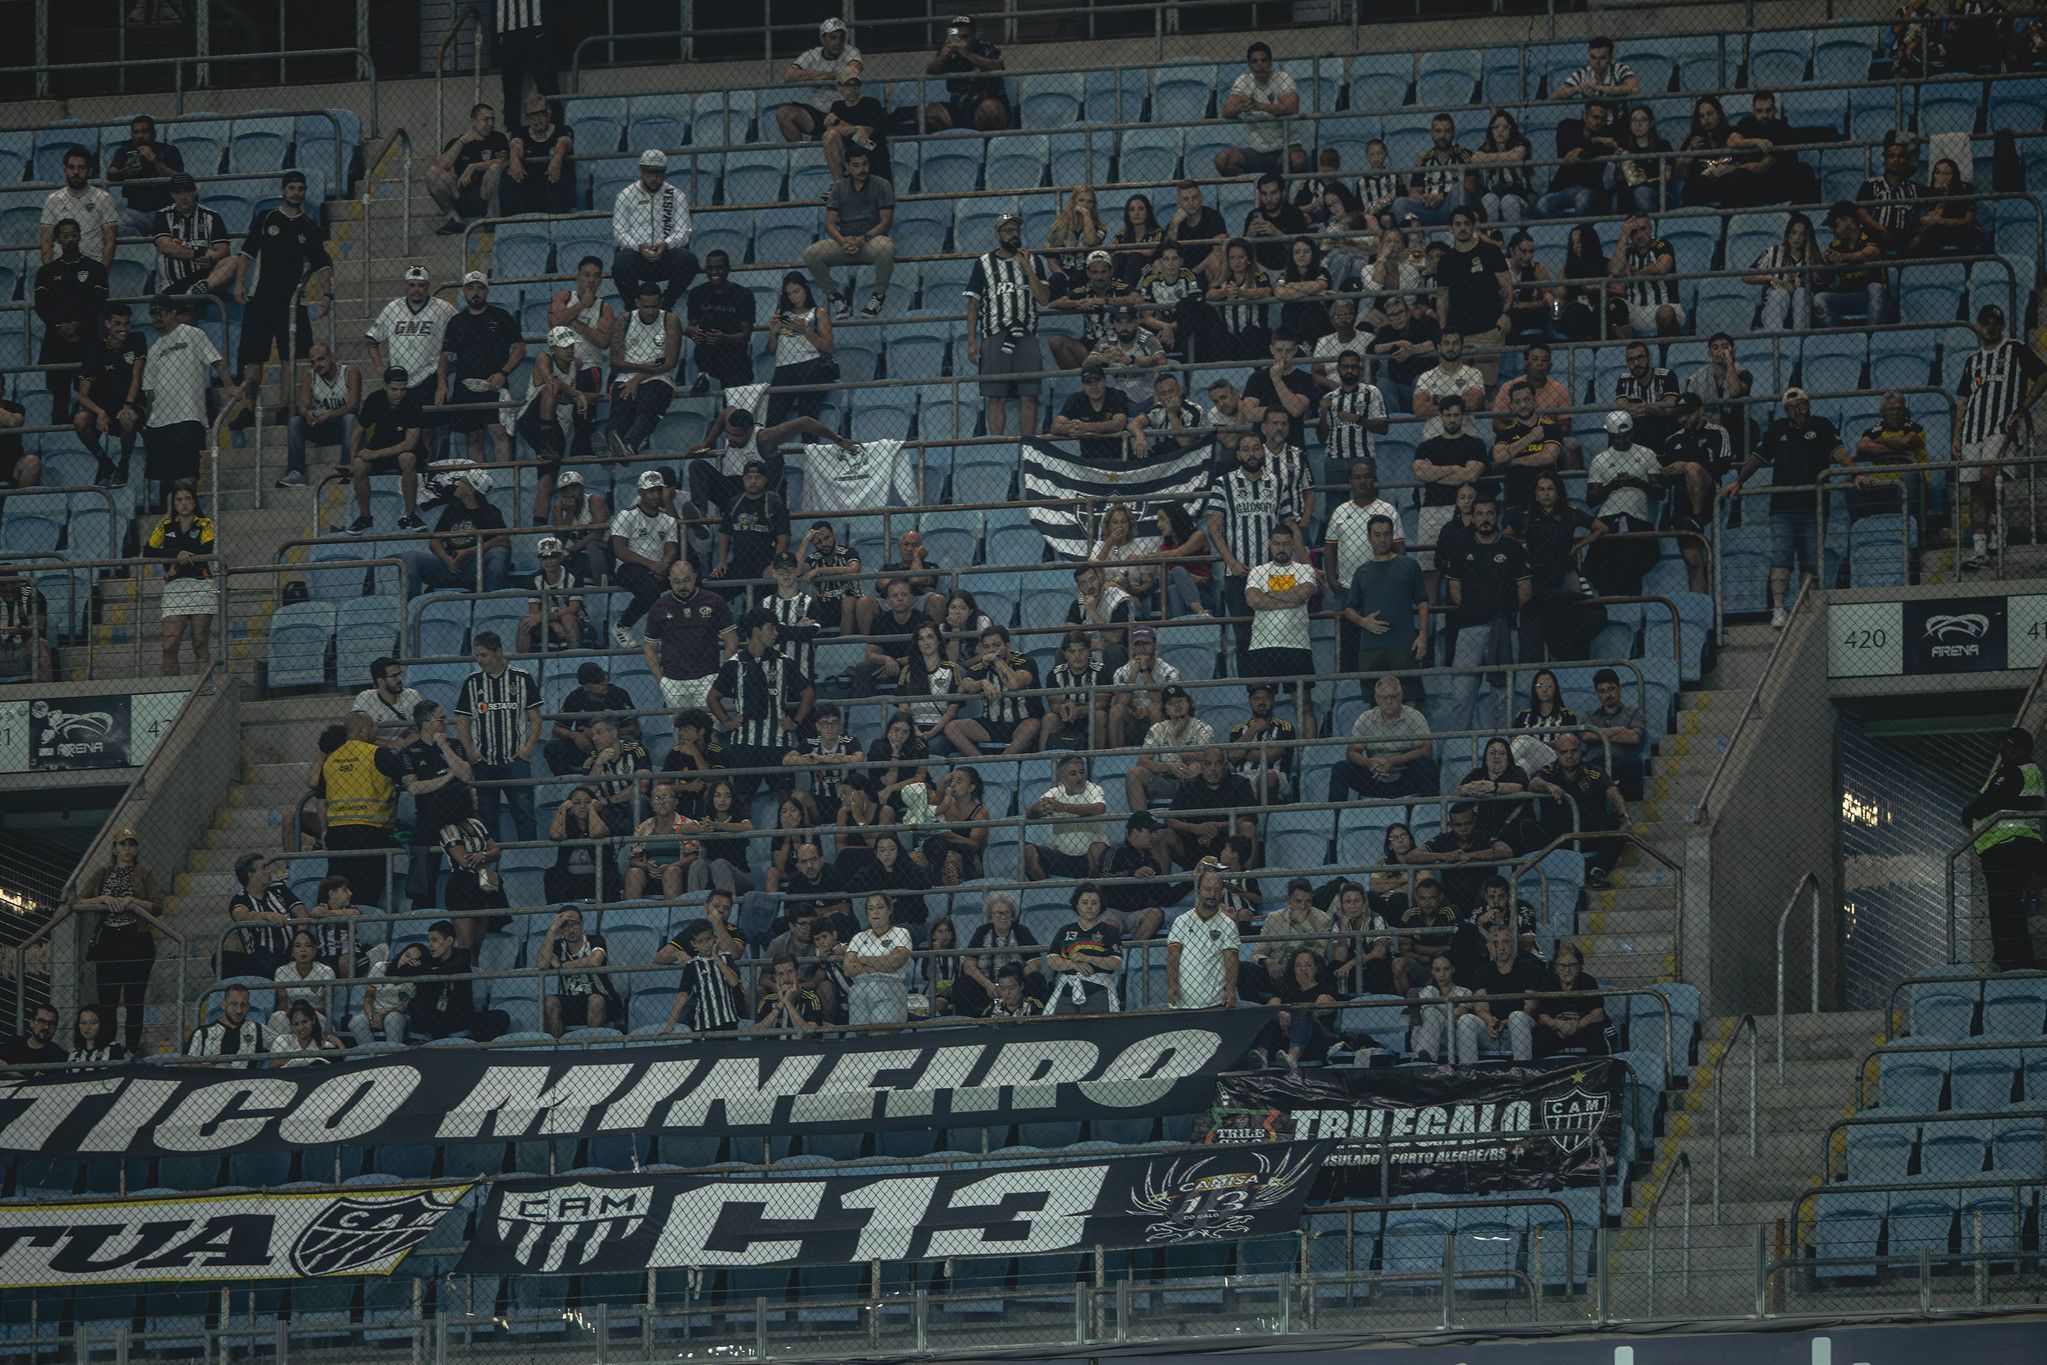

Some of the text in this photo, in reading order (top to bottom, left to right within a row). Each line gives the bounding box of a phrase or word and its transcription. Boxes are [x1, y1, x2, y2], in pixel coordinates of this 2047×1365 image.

[1843, 629, 1886, 649] 420
[1931, 644, 1979, 658] ARENA
[1065, 931, 1078, 941] 13
[434, 1029, 1222, 1138] MINEIRO
[0, 1065, 422, 1152] TICO
[1552, 1098, 1600, 1115] CAM
[1290, 1100, 1532, 1149] TRILEGALO
[1390, 1150, 1436, 1165] PORTO
[1435, 1147, 1508, 1163] ALEGRE/RS
[1179, 1174, 1259, 1193] CAMISA
[519, 1193, 637, 1218] CAM
[1183, 1190, 1249, 1213] 13
[339, 1210, 448, 1231] CAM
[646, 1165, 1110, 1268] C13
